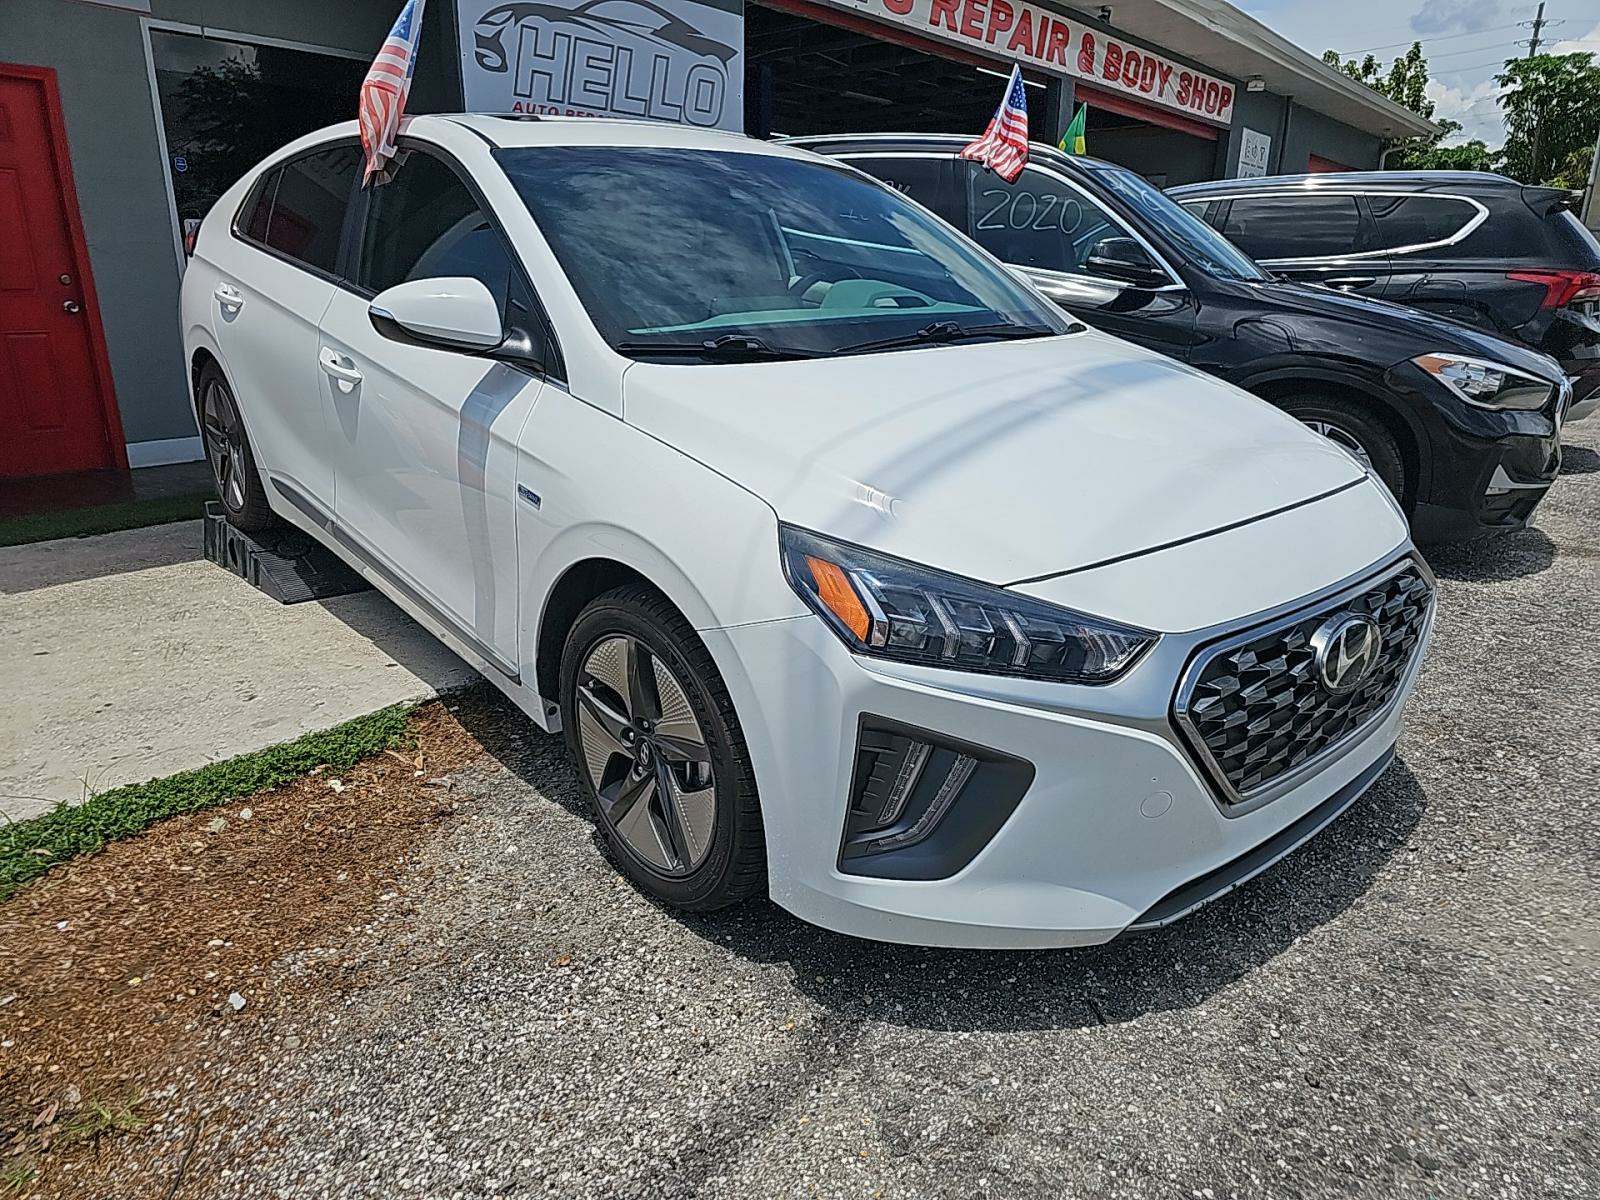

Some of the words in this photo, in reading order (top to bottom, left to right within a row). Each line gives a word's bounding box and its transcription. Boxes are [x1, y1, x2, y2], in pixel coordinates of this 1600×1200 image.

[513, 24, 725, 128] HELLO
[929, 0, 1070, 67] REPAIR
[1077, 32, 1095, 75] &
[1102, 41, 1173, 98] BODY
[1176, 71, 1232, 117] SHOP
[512, 101, 560, 116] AUTO
[977, 189, 1083, 235] 2020
